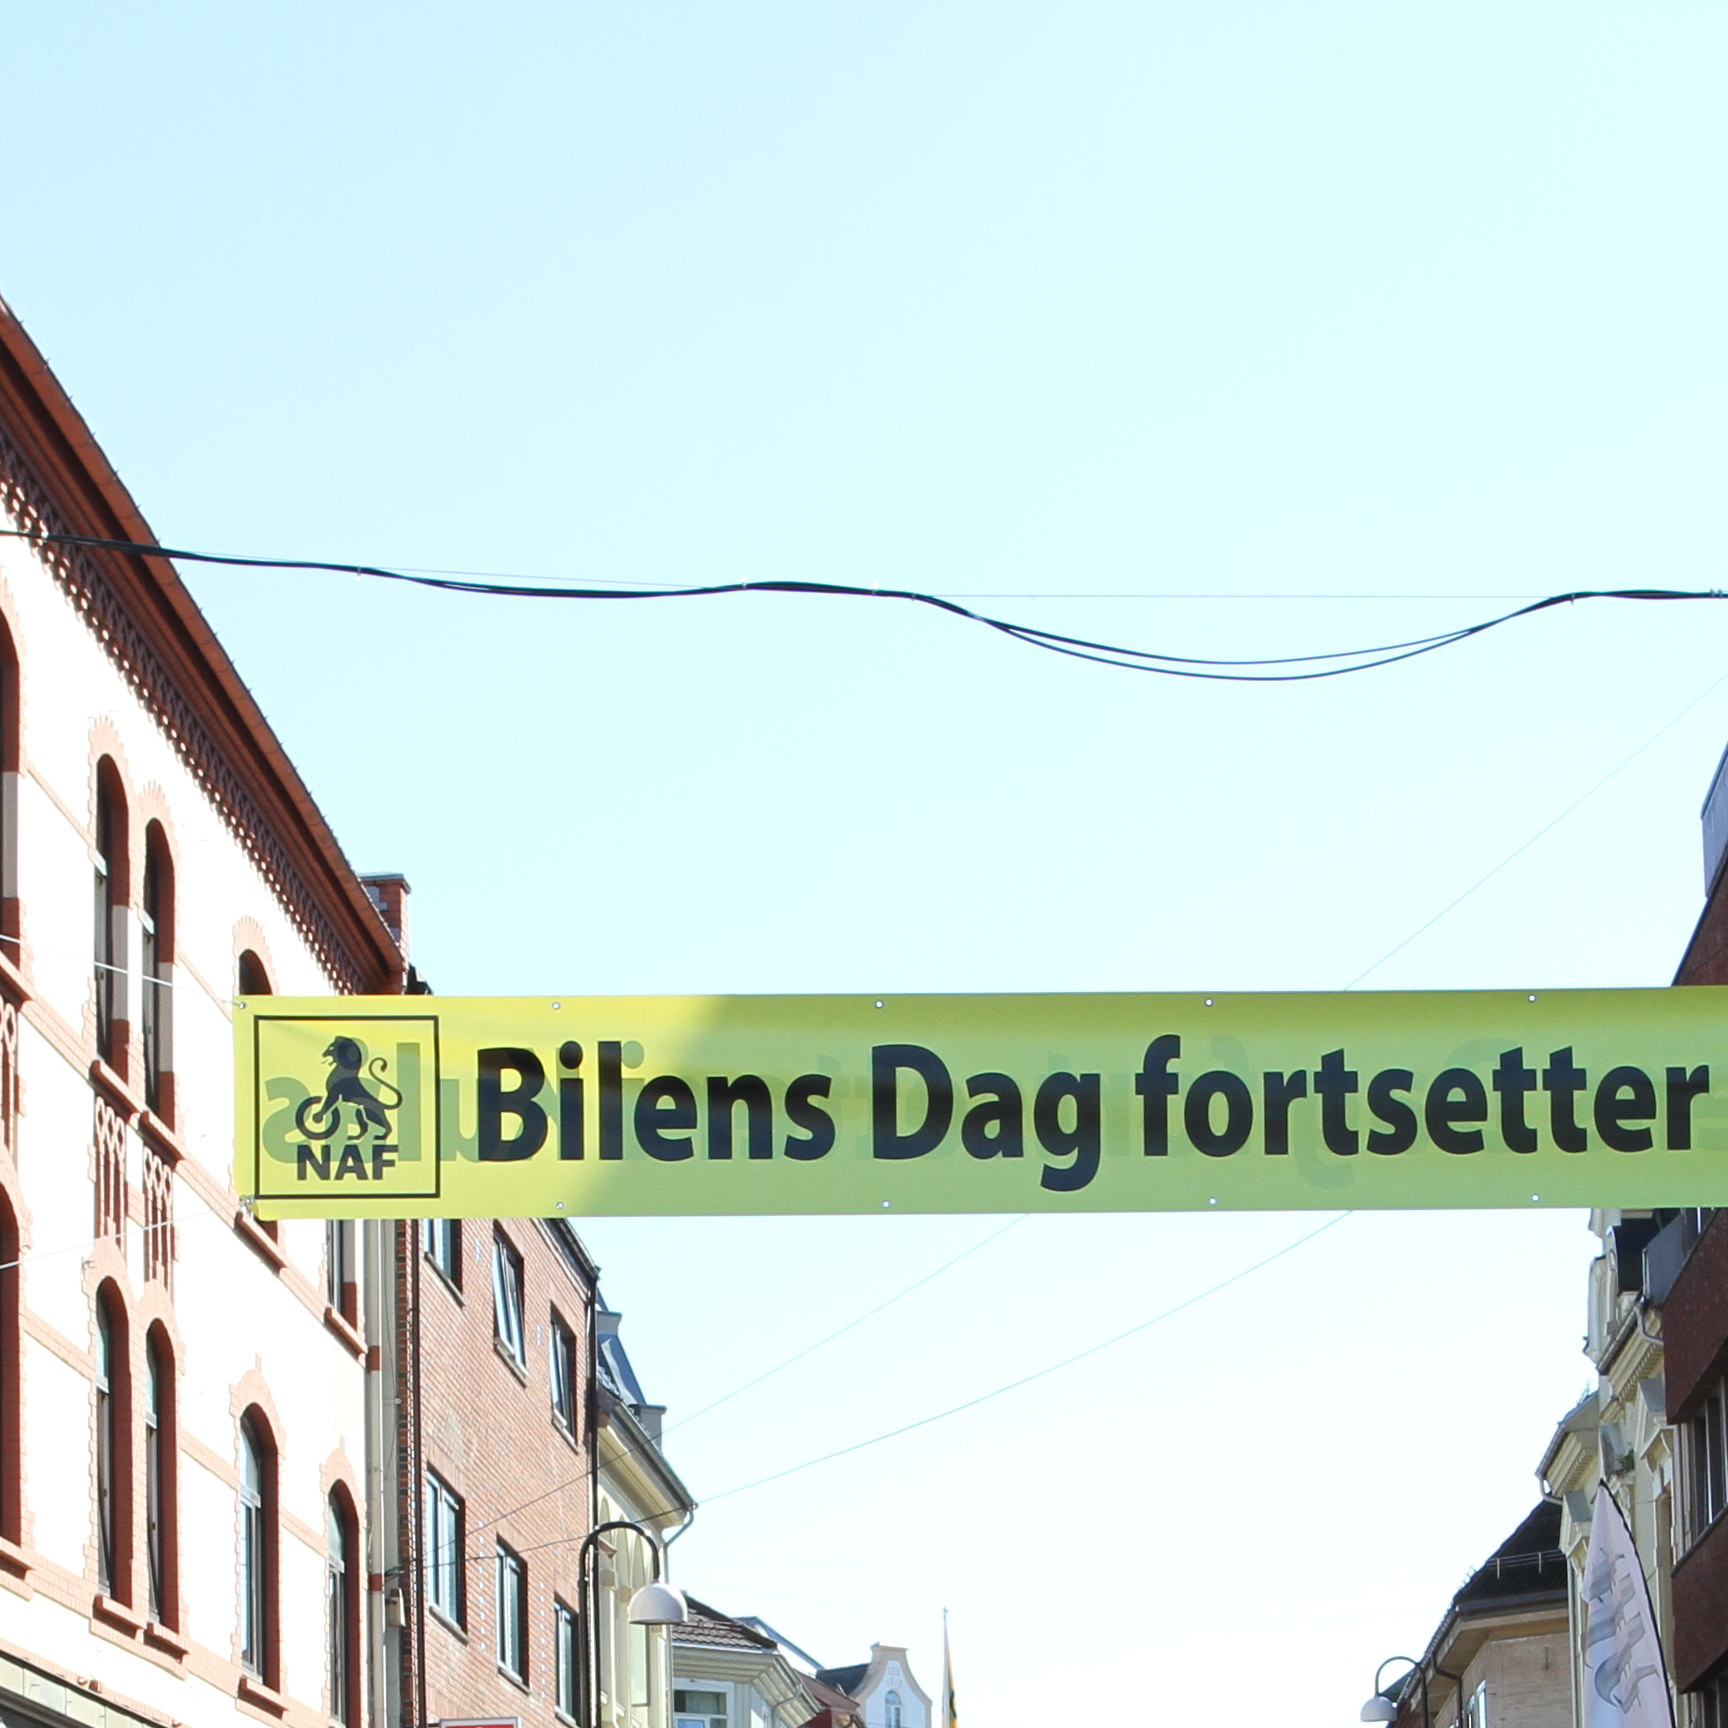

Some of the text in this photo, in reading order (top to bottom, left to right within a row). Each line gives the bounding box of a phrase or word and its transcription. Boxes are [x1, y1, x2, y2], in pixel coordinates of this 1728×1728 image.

[477, 1040, 835, 1164] Bilens
[872, 1044, 1101, 1192] Dag
[1135, 1034, 1709, 1157] fortsetter
[296, 1145, 400, 1181] NAF
